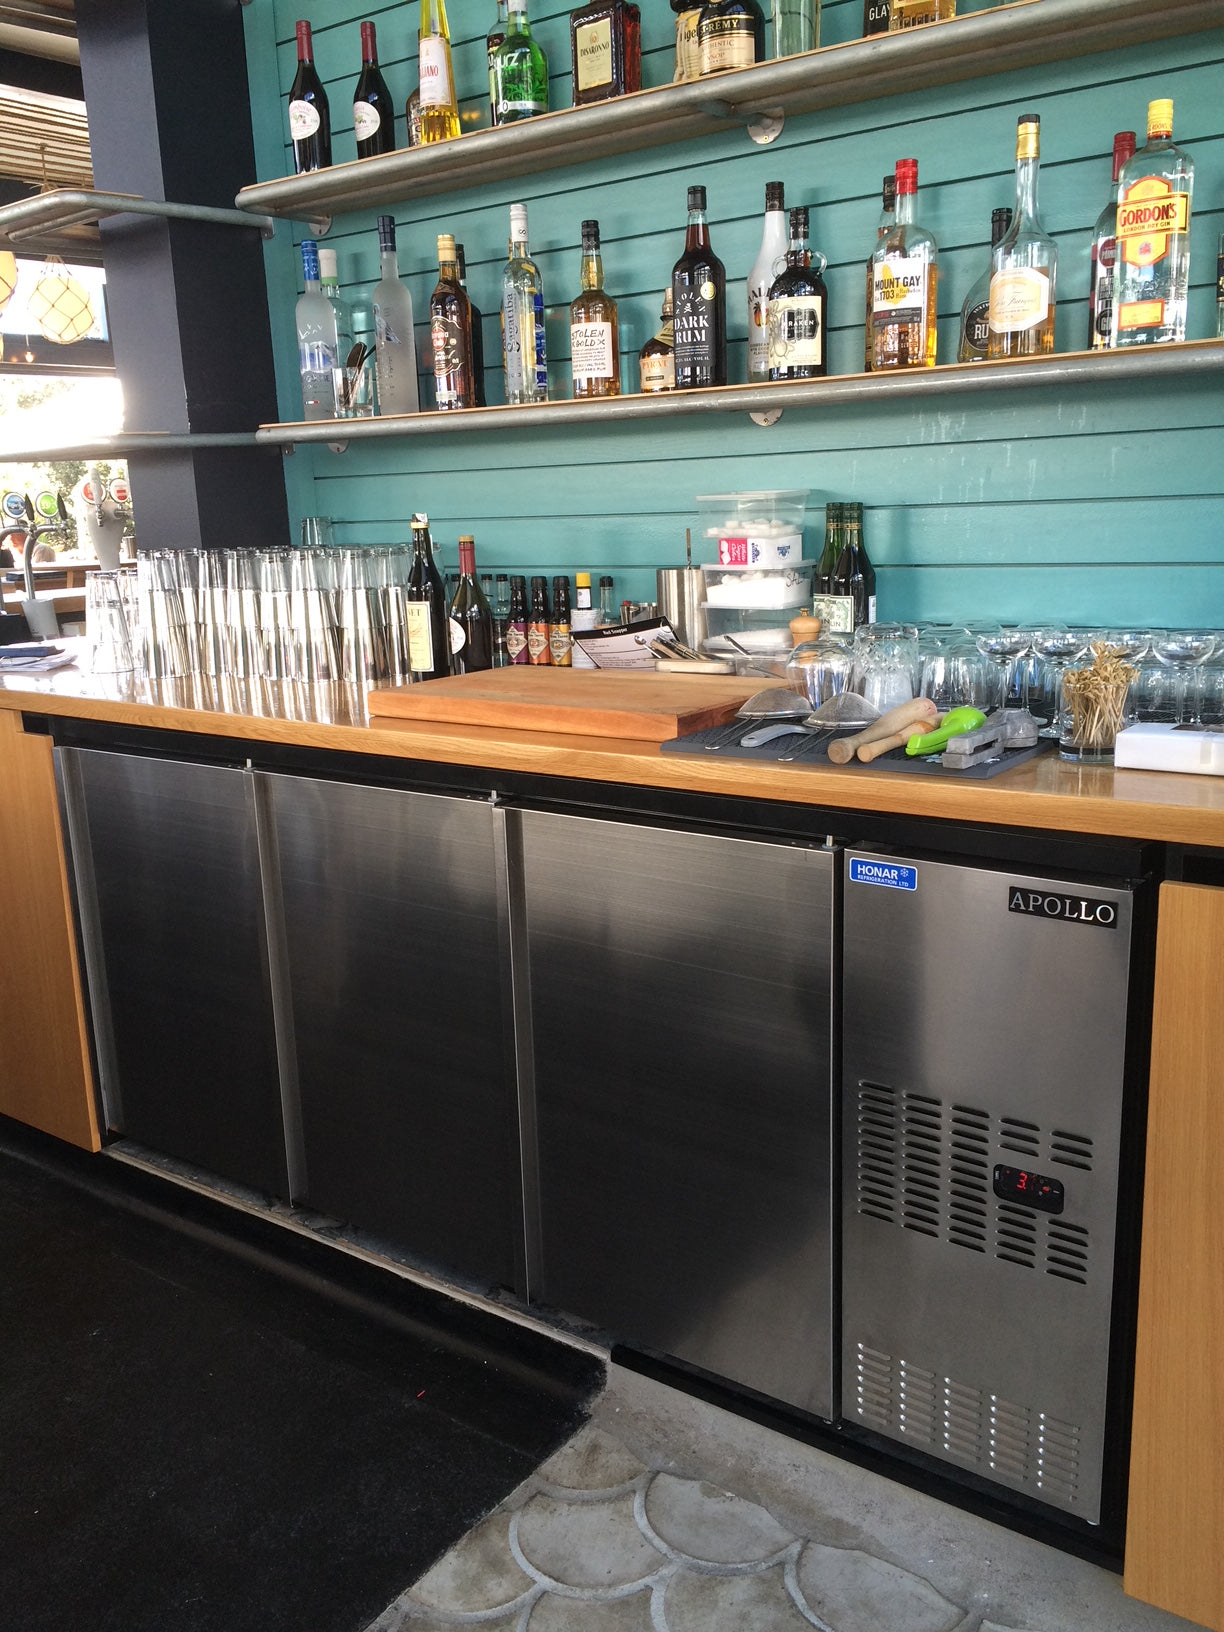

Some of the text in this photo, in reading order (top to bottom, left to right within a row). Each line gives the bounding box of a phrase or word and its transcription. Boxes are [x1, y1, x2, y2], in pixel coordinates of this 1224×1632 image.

[580, 41, 610, 57] DISARONNO
[1120, 203, 1177, 227] GORDON'S
[1123, 224, 1145, 233] LONDON
[875, 275, 921, 291] MOUNT GAY
[880, 290, 895, 301] 1703
[675, 315, 709, 330] DARK
[572, 329, 605, 340] STOLEN
[676, 329, 706, 344] RUM
[857, 864, 899, 880] HONAR
[857, 875, 898, 886] REFRIGERATION
[1010, 892, 1114, 923] APOLLO
